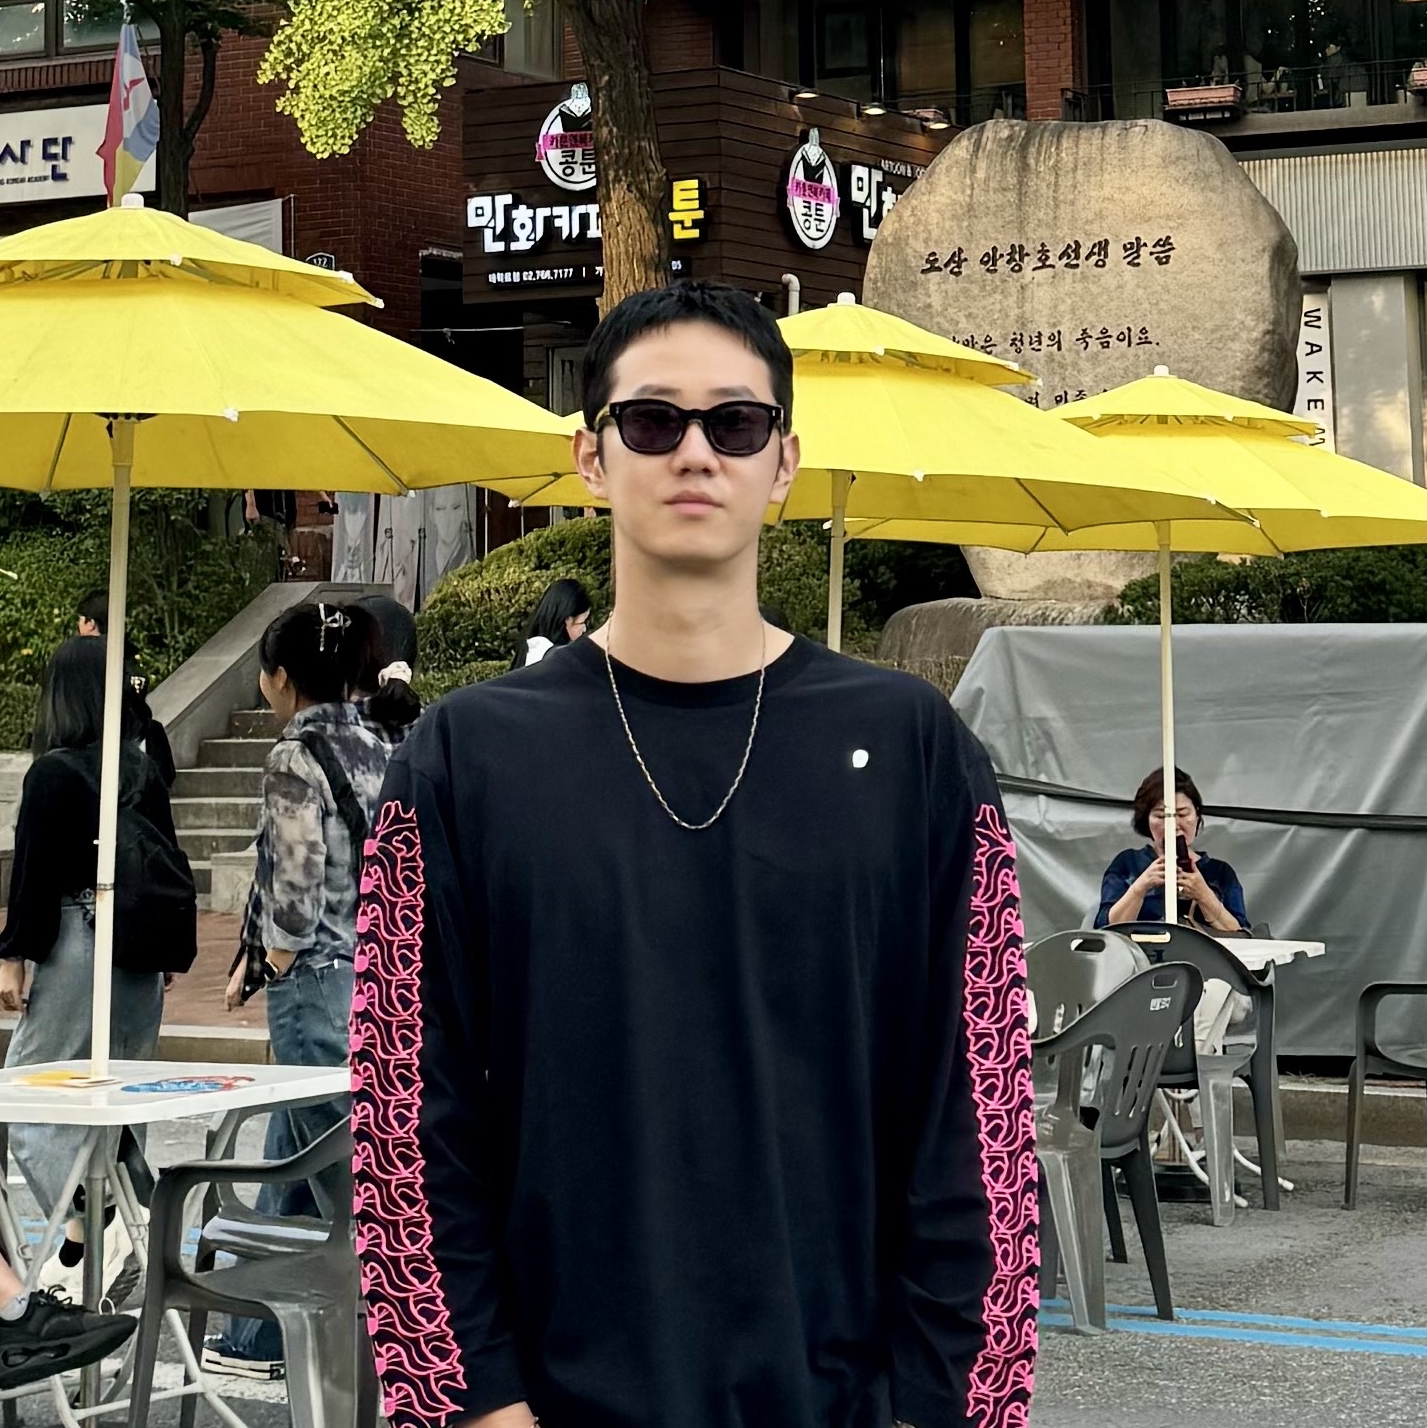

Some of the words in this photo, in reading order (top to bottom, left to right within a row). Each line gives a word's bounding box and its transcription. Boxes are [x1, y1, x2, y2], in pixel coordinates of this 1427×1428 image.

[668, 179, 705, 240] 툰
[801, 199, 826, 233] 콩툰
[921, 247, 967, 276] 도산
[980, 238, 1110, 274] 안창호선생
[1122, 235, 1175, 268] 말씀
[1009, 329, 1063, 355] 청년의
